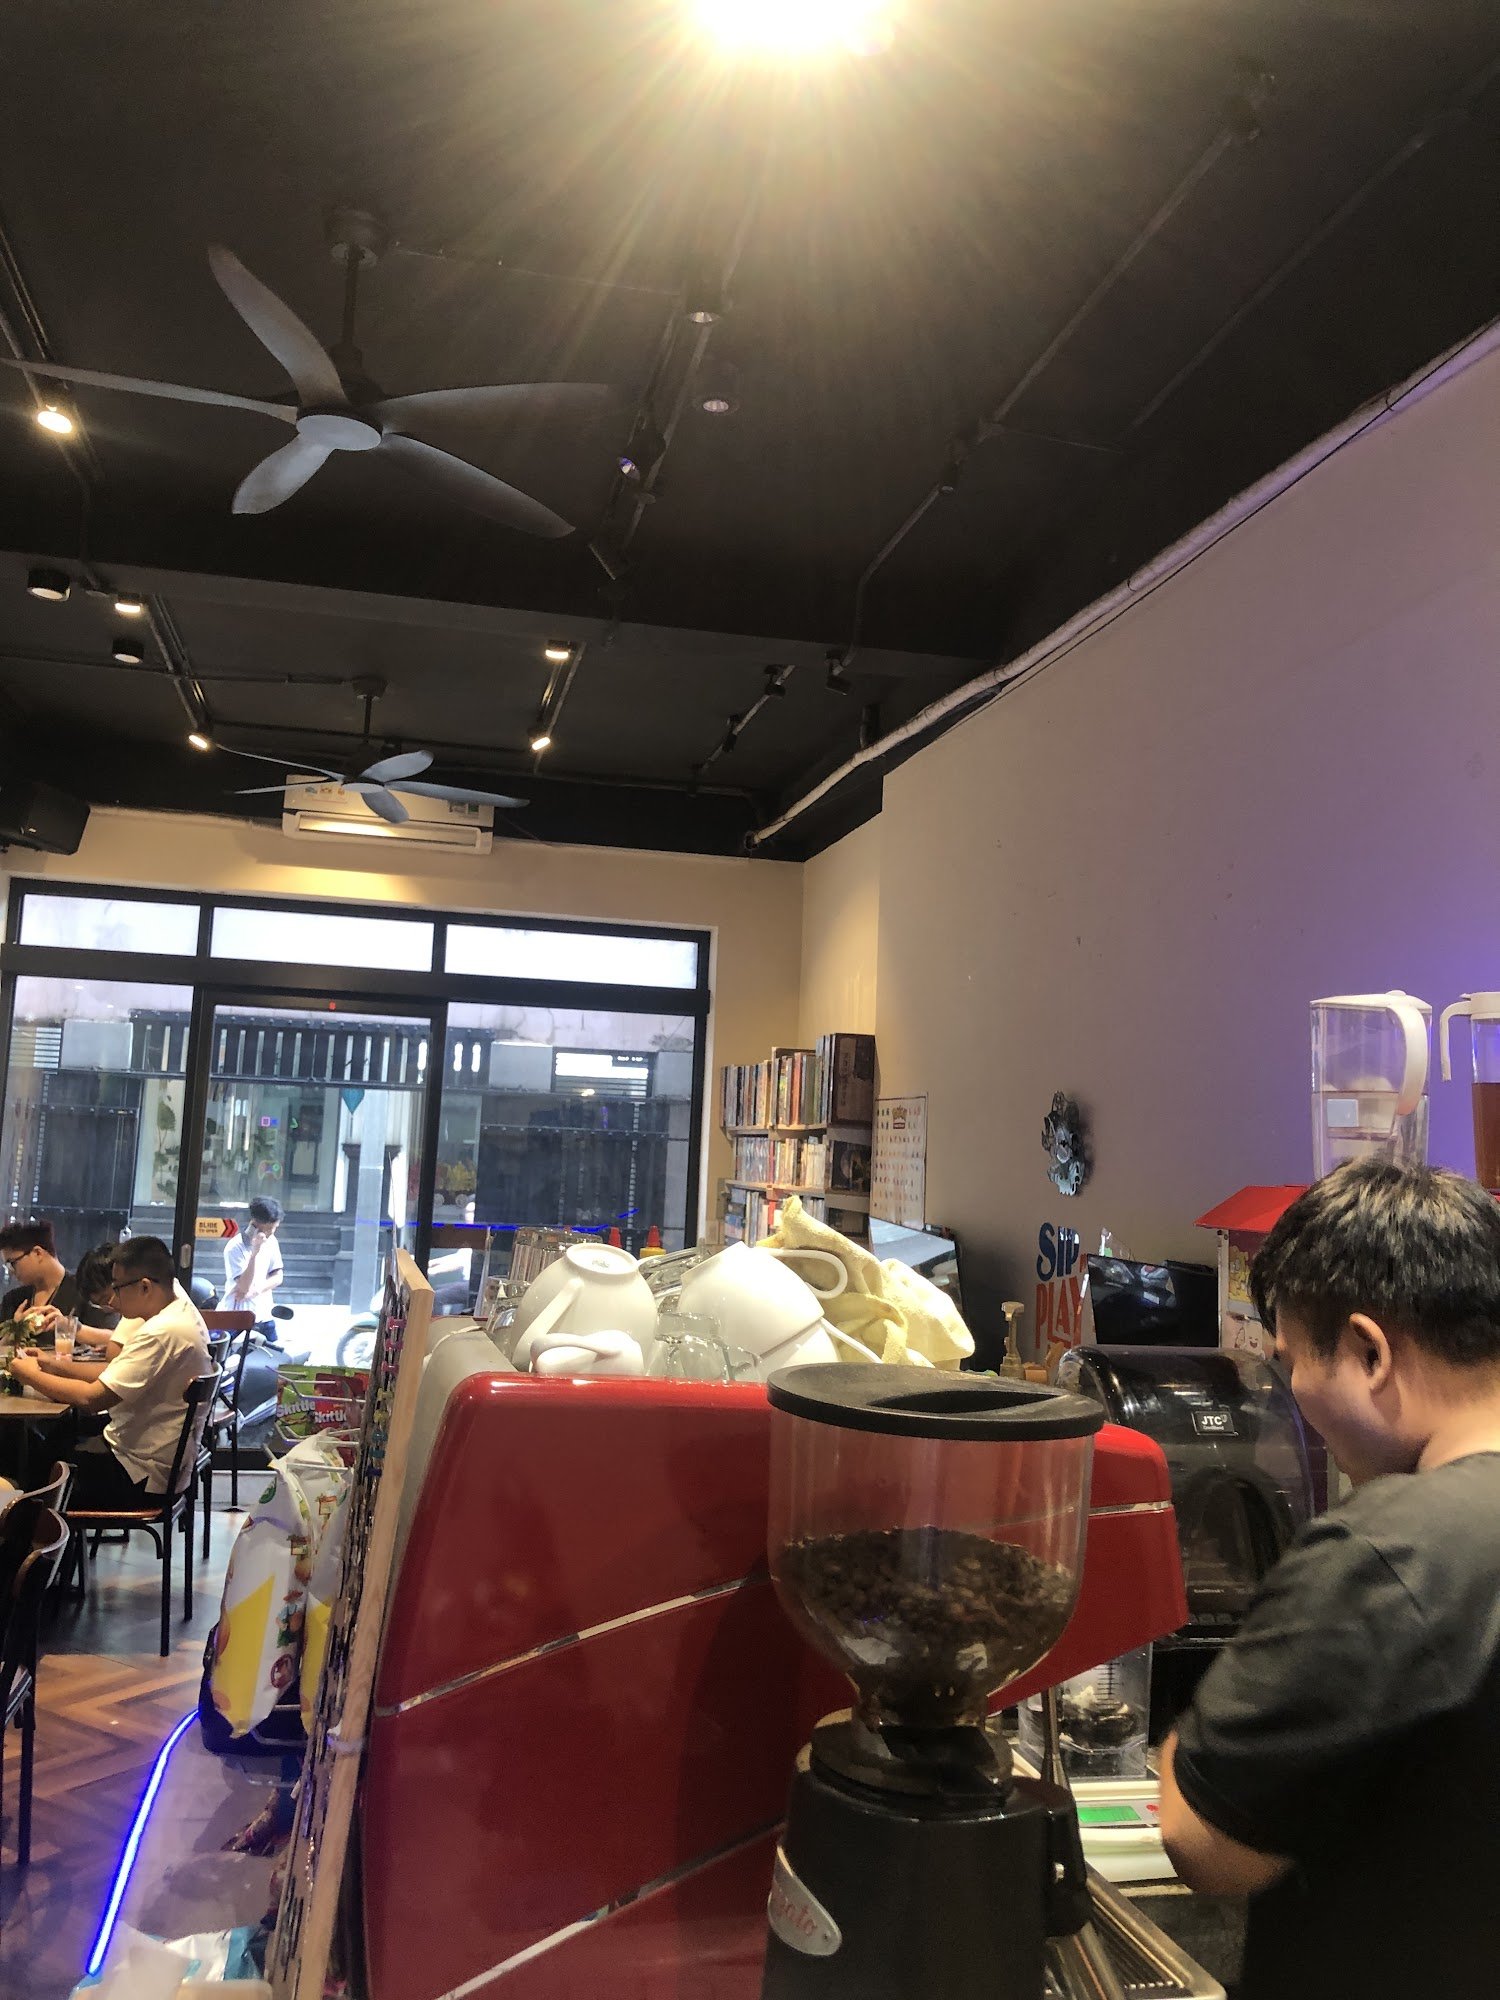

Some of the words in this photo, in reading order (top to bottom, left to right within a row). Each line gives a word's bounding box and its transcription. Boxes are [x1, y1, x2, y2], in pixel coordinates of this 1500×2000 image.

[1036, 1221, 1080, 1282] SIP
[1035, 1275, 1088, 1350] PLAY
[276, 1399, 316, 1418] Skittle
[314, 1409, 347, 1423] Skittl
[1201, 1415, 1223, 1426] JTC
